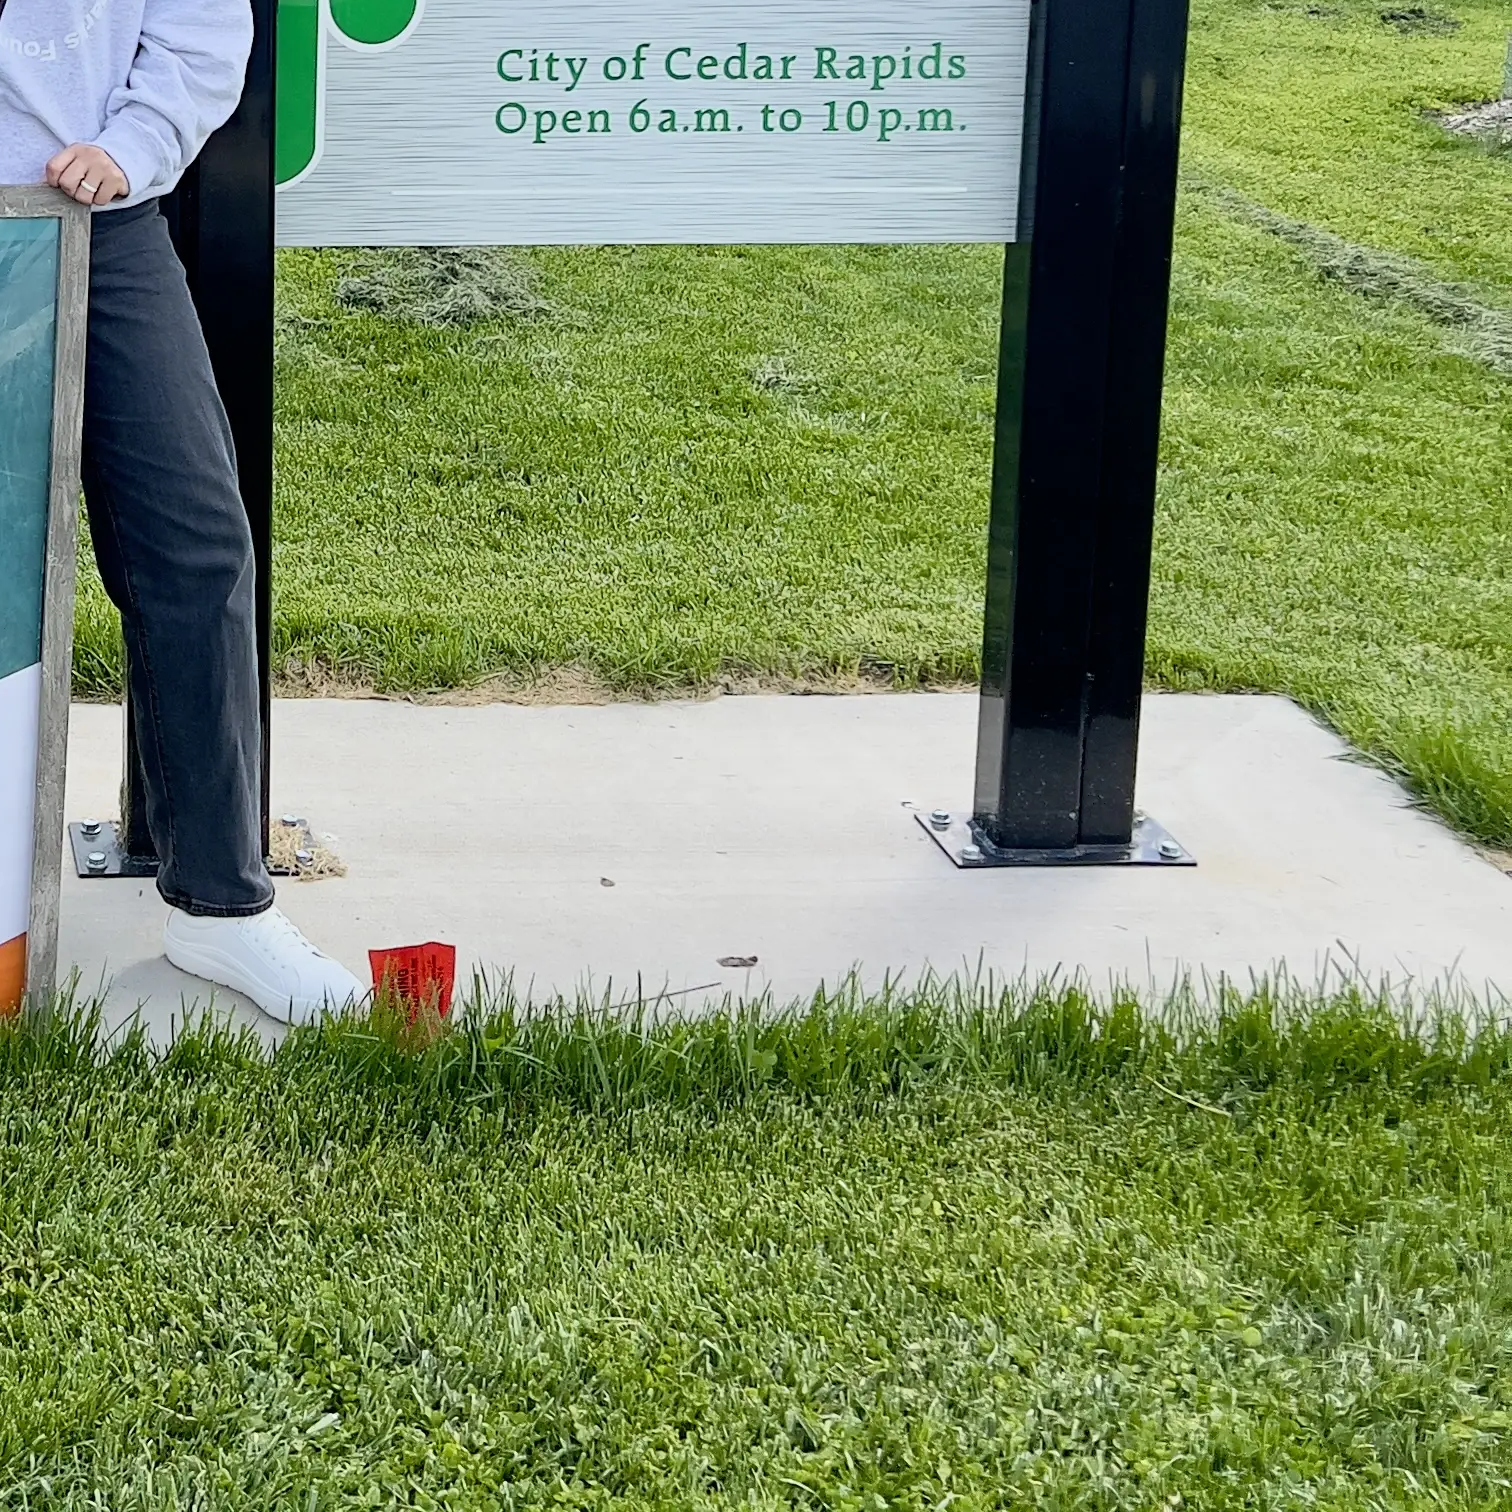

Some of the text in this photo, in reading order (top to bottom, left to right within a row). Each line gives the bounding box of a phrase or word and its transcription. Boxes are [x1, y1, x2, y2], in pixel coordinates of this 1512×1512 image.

[496, 42, 967, 92] City of Cedar Rapids
[494, 101, 612, 144] Open
[760, 103, 803, 133] to
